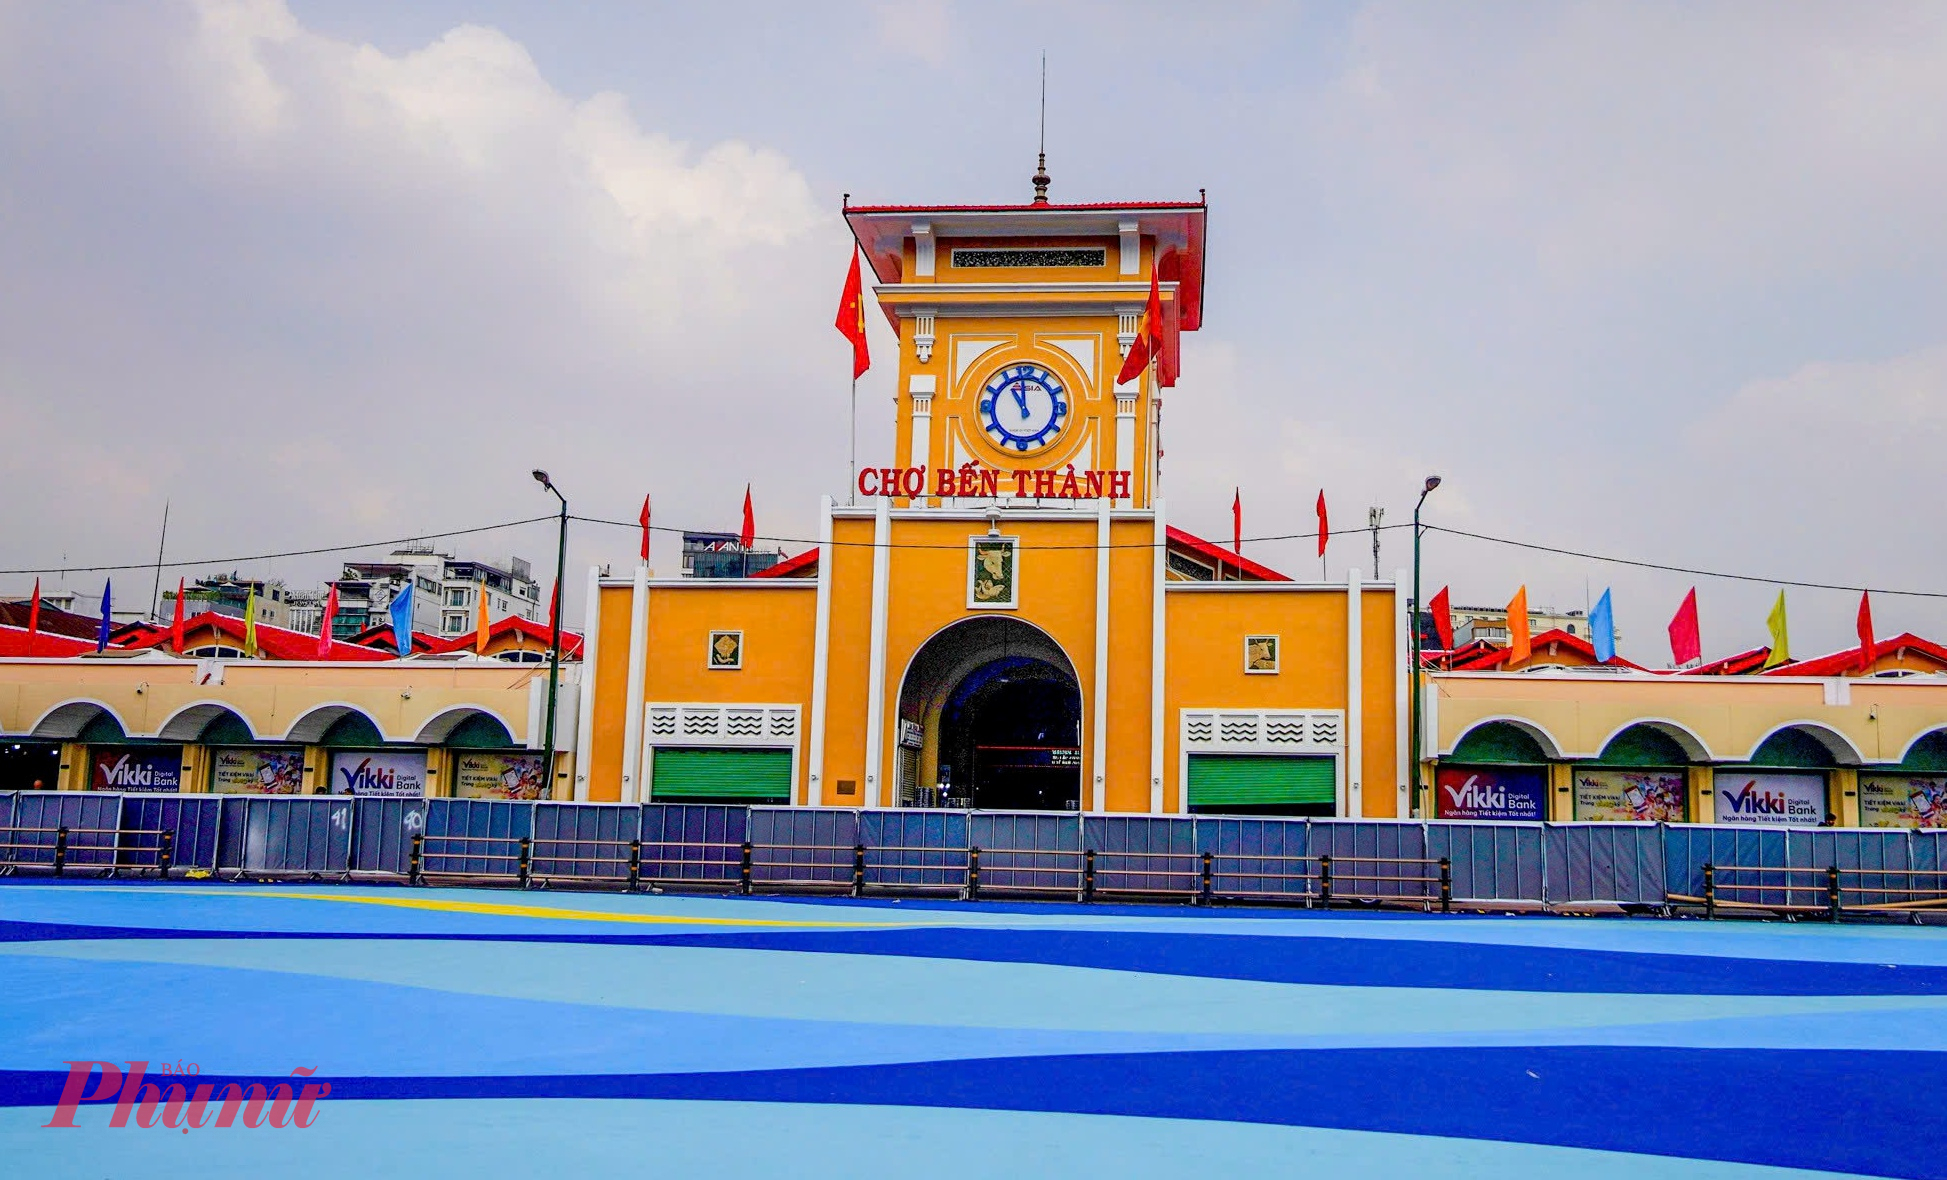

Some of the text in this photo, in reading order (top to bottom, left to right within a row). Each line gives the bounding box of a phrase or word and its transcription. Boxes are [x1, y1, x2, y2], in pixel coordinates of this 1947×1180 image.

[1016, 365, 1035, 377] 12
[858, 460, 1131, 500] CHỢ BẾN THÀNH
[100, 753, 153, 785] Vikki
[340, 757, 394, 789] Vikki
[154, 777, 178, 786] Bank
[396, 780, 421, 789] Bank
[1444, 774, 1506, 808] Vikki
[1508, 799, 1537, 809] Bank
[1722, 780, 1785, 814] Vikki
[331, 807, 347, 830] 41
[403, 809, 422, 831] 40
[1788, 805, 1817, 814] Bank
